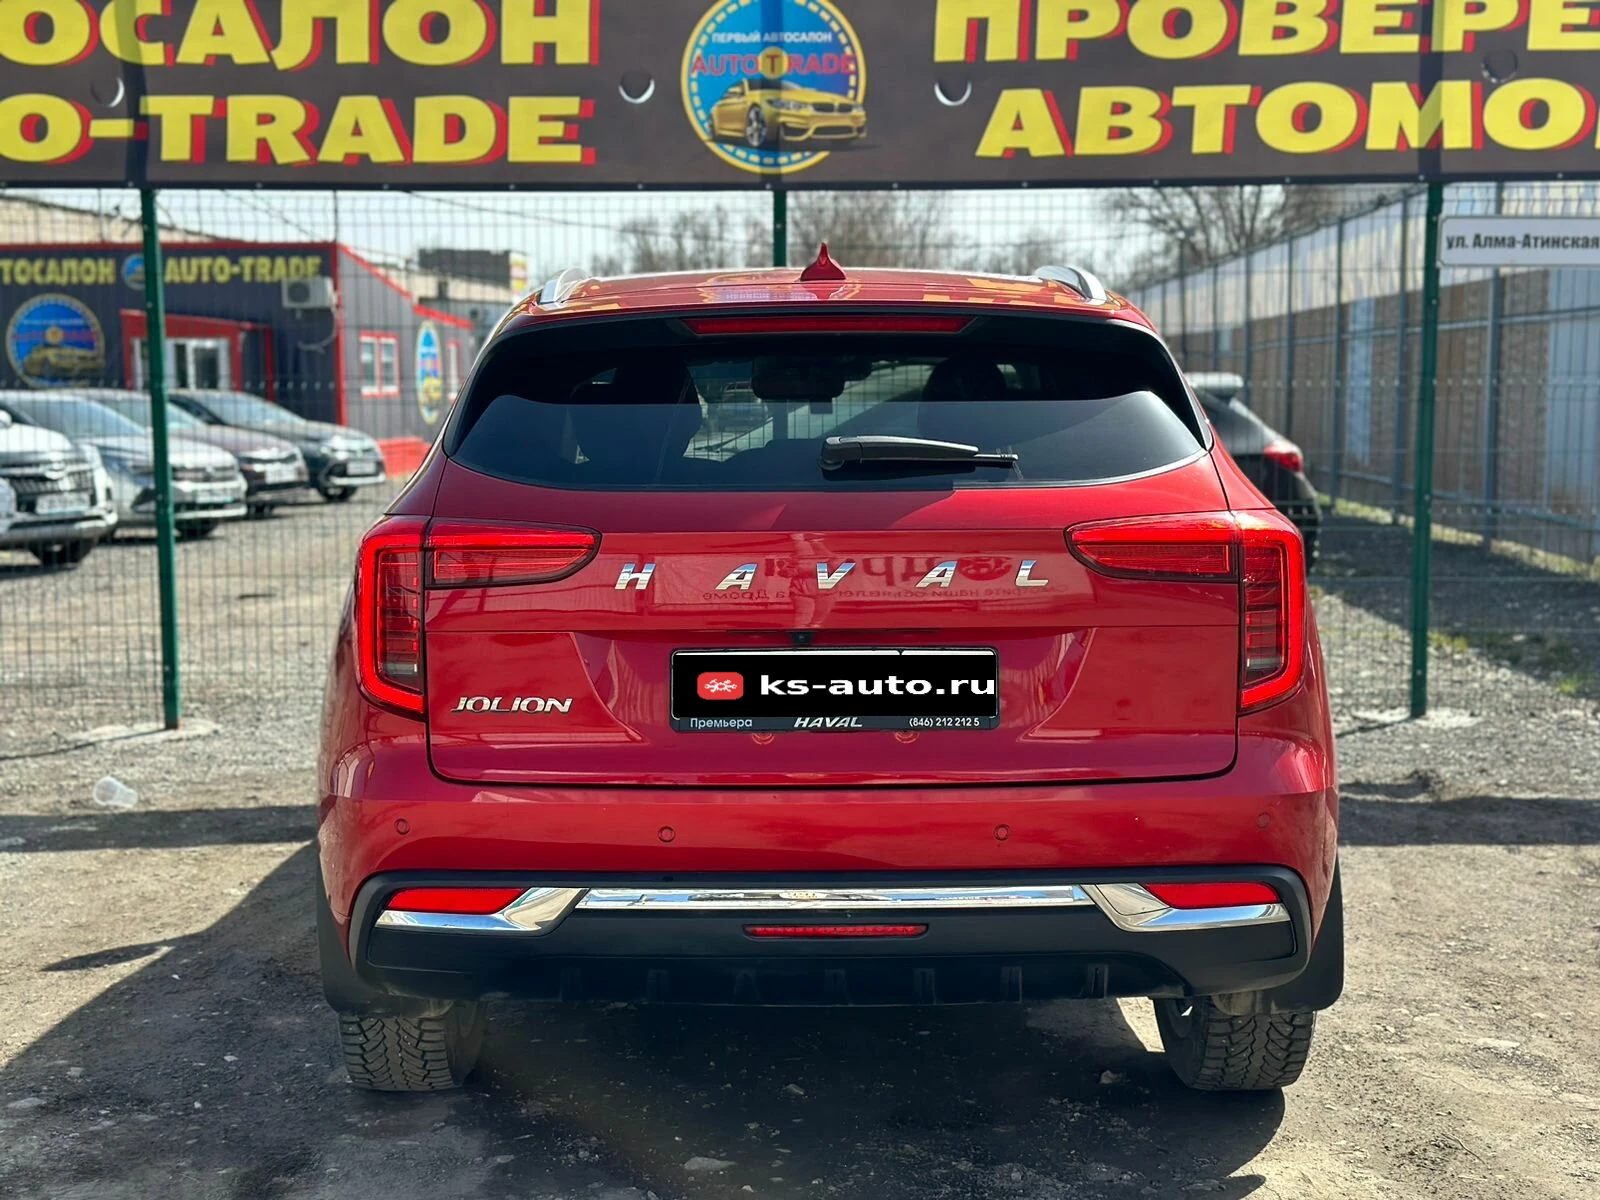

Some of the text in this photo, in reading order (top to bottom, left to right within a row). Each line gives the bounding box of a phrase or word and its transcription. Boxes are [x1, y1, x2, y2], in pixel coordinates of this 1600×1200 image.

[712, 31, 832, 43] ПЕРВЫЙ АВТОСАЛОН
[975, 79, 1600, 158] АВТОМО
[0, 93, 597, 166] O-TRADE
[1446, 233, 1600, 250] ул. Алма-Атинская
[164, 255, 322, 284] AUTO-TRADE
[614, 561, 1050, 592] HAVAL
[452, 696, 573, 714] JOLION
[690, 717, 753, 729] Премьера
[794, 717, 863, 728] HAVAL
[909, 717, 934, 727] (846)
